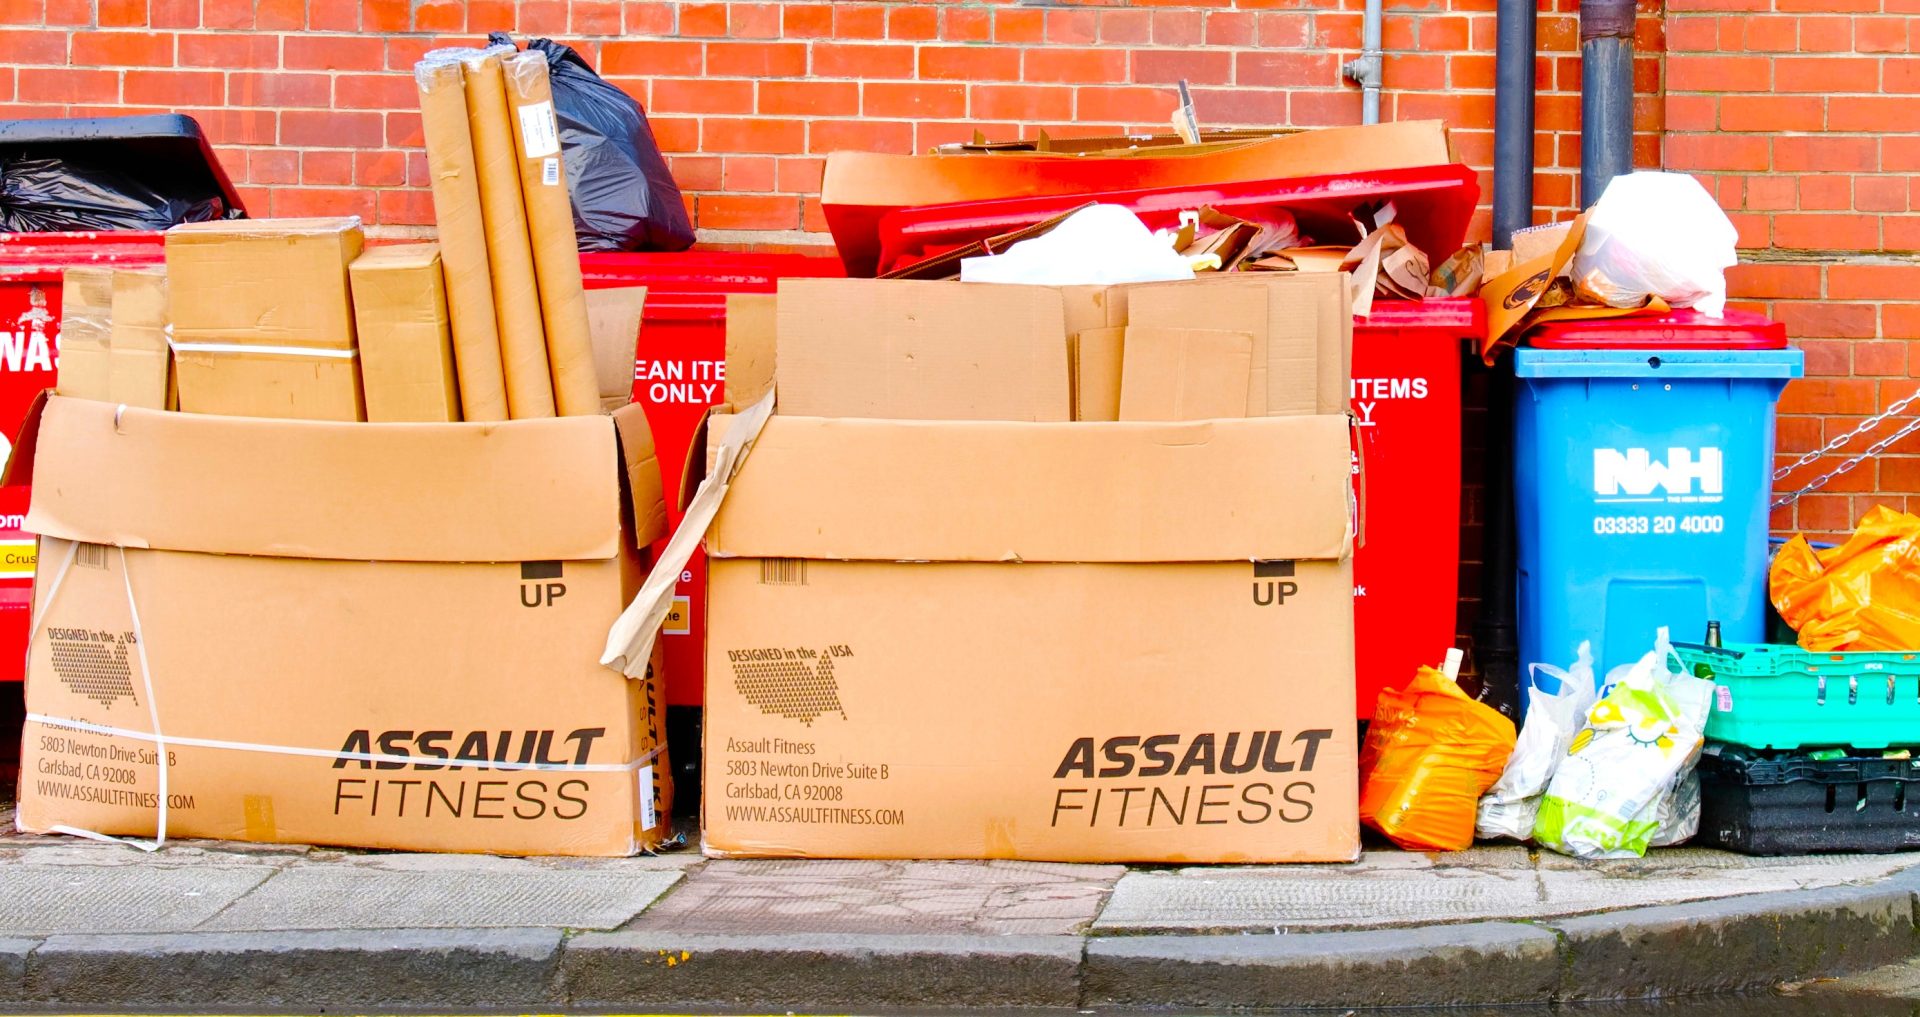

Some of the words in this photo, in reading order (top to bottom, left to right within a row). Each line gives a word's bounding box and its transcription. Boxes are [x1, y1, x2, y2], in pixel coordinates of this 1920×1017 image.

[649, 383, 717, 403] ONLY
[1350, 378, 1428, 399] ITEMS
[1594, 447, 1723, 495] NWH
[1594, 516, 1648, 534] 03333
[1653, 516, 1675, 533] 20
[1680, 515, 1723, 533] 4000
[520, 583, 566, 608] UP
[1253, 582, 1298, 606] UP
[48, 627, 89, 641] DESIGNED
[89, 630, 98, 642] in
[100, 630, 115, 643] the
[124, 632, 138, 643] US
[728, 648, 782, 662] DESIGNED
[782, 647, 793, 660] in
[797, 646, 817, 660] the
[829, 645, 854, 659] USA
[40, 736, 65, 753] 5803
[67, 739, 108, 759] Newton
[110, 745, 136, 763] Drive
[138, 748, 160, 766] Suit
[168, 752, 177, 767] B
[332, 727, 606, 771] ASSAULT
[726, 737, 771, 754] Assault
[774, 738, 815, 755] Fitness
[1053, 729, 1333, 779] ASSAULT
[38, 758, 84, 780] Carlsbad,
[86, 764, 100, 780] CA
[103, 767, 136, 784] 92008
[726, 760, 757, 776] 5803
[760, 761, 809, 778] Newton
[812, 762, 844, 779] Drive
[846, 763, 878, 780] Suite
[880, 764, 889, 780] B
[334, 778, 589, 820] FITNESS
[726, 782, 781, 802] Carlsbad,
[784, 784, 801, 800] CA
[804, 785, 843, 801] 92008
[1051, 781, 1316, 827] FITNESS
[726, 805, 905, 826] WWW.ASSAULTFITNESS.COM
